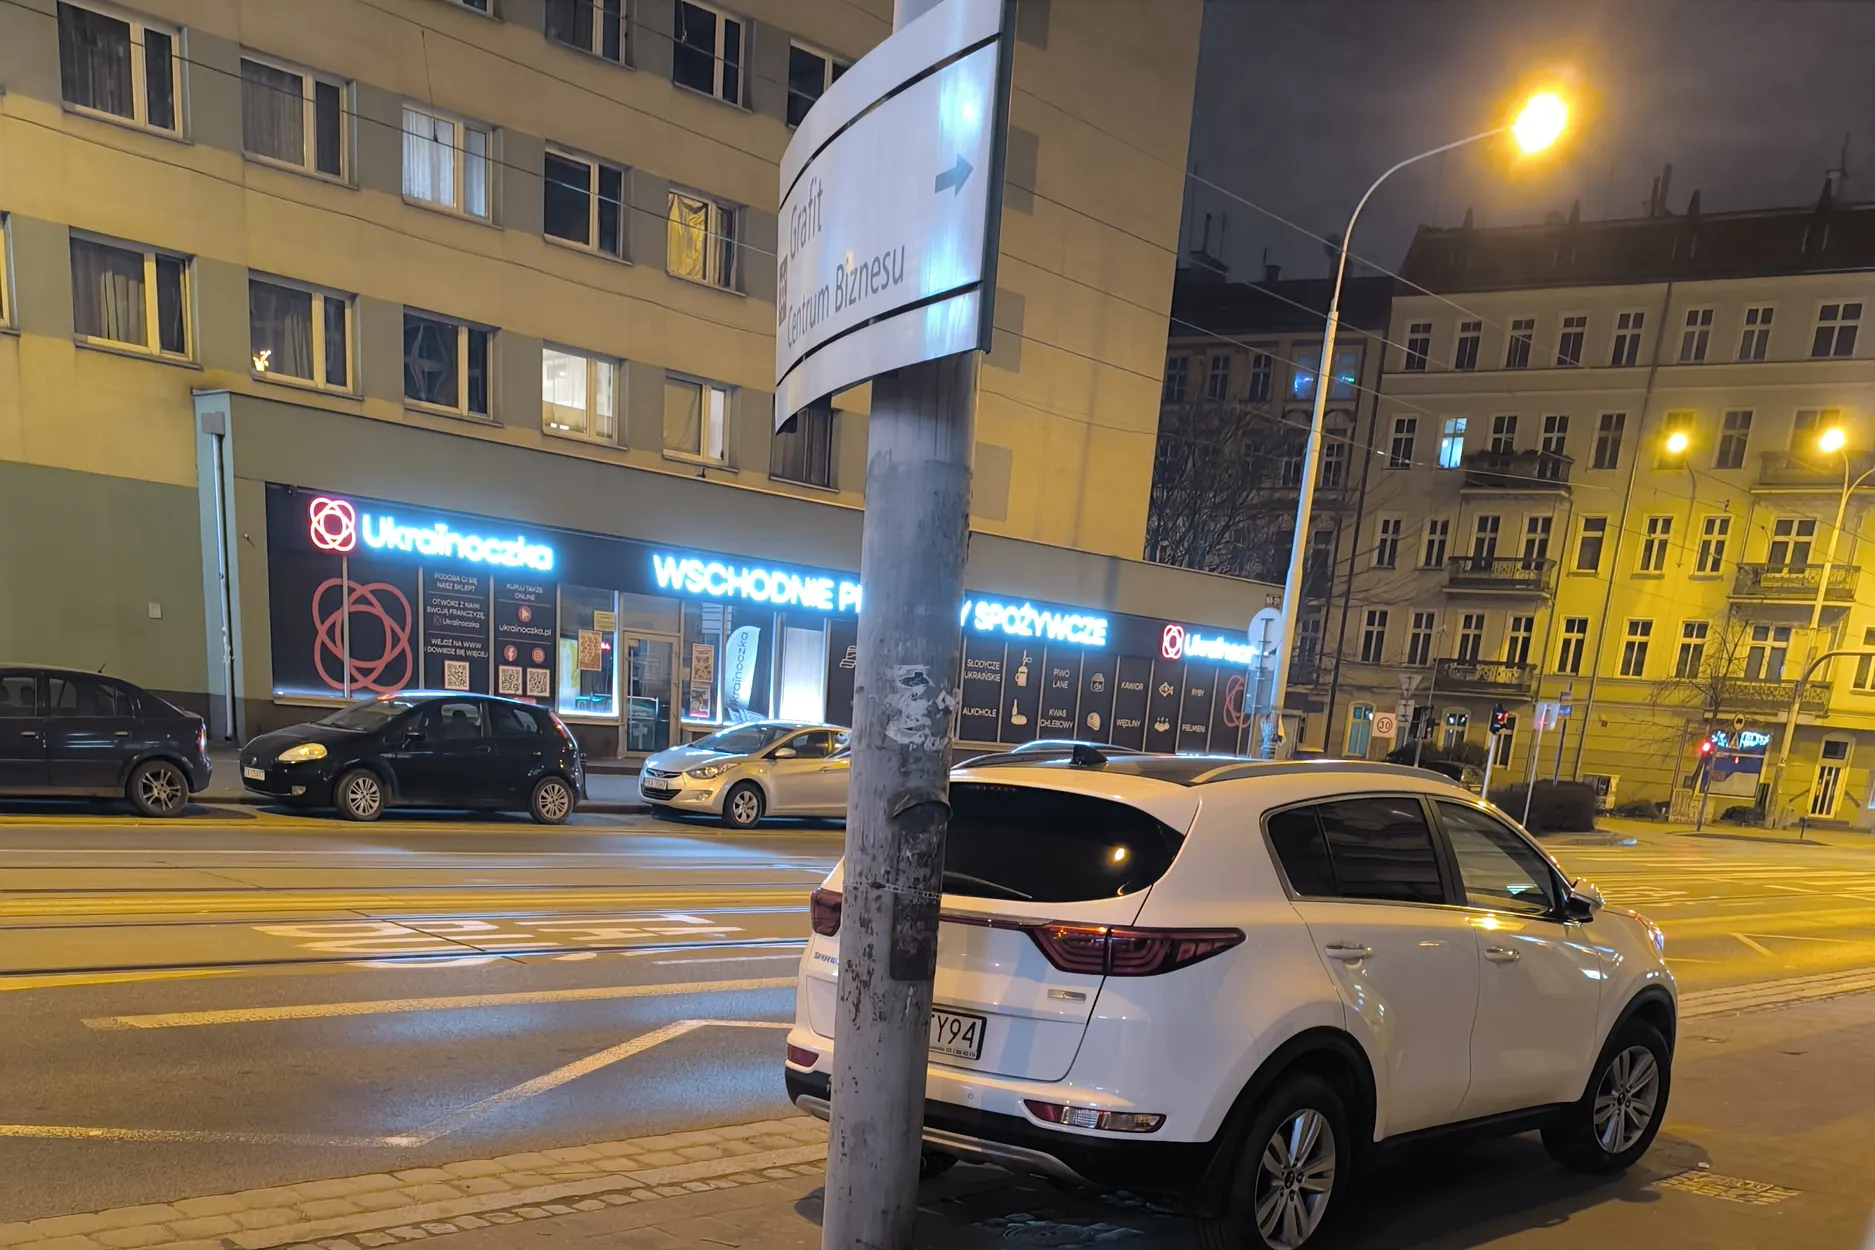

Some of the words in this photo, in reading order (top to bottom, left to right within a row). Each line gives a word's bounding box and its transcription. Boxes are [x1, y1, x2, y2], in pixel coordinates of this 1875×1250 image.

[789, 176, 823, 260] Grafit
[787, 284, 830, 348] Centrum
[835, 245, 905, 313] Biznesu
[436, 581, 453, 589] NASZ
[453, 583, 476, 592] SKLEP?
[432, 598, 459, 607] OTWÓRZ
[653, 554, 834, 610] WSCHODNIE
[974, 601, 1108, 646] SPOŻYWCZE
[730, 631, 748, 706] kraïnoczka
[967, 659, 1000, 670] SŁODYCZE
[964, 670, 1000, 682] UKRAIŃSKIE
[1053, 668, 1070, 678] PIWO
[1052, 680, 1068, 688] LANE
[1121, 681, 1144, 690] KAWIOR
[1191, 688, 1205, 697] RYBY
[962, 707, 997, 717] ALKOHOLE
[1040, 719, 1074, 729] CHLEBOWY
[1116, 718, 1141, 728] WĘDLINY
[1379, 720, 1391, 730] 30
[932, 1014, 976, 1048] Y94
